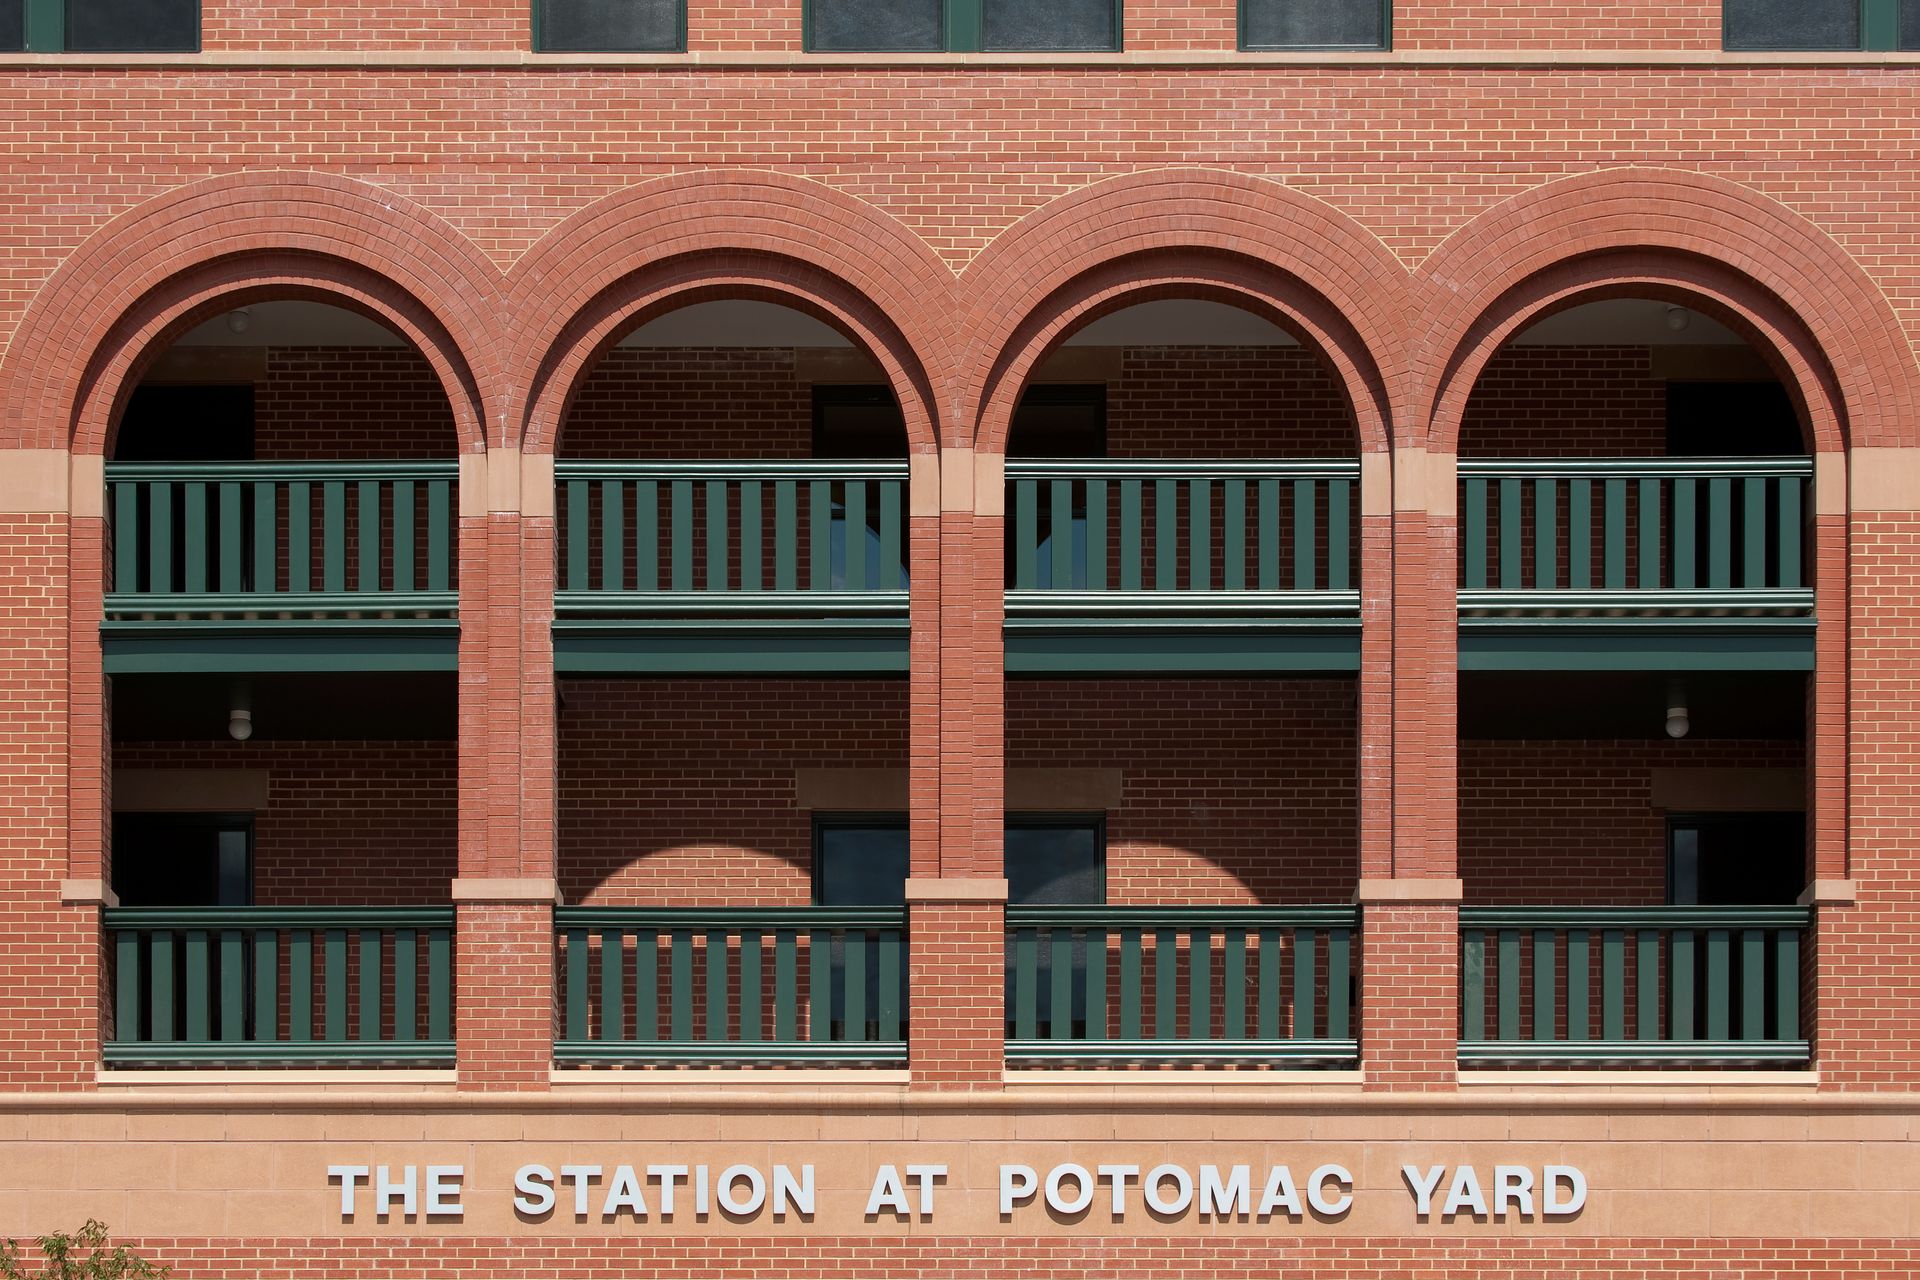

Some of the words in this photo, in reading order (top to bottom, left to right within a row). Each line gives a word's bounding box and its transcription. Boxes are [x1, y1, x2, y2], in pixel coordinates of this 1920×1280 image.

[327, 1164, 465, 1216] THE
[512, 1163, 816, 1216] STATION
[865, 1164, 949, 1216] AT
[998, 1162, 1354, 1216] POTOMAC
[1401, 1164, 1588, 1216] YARD
